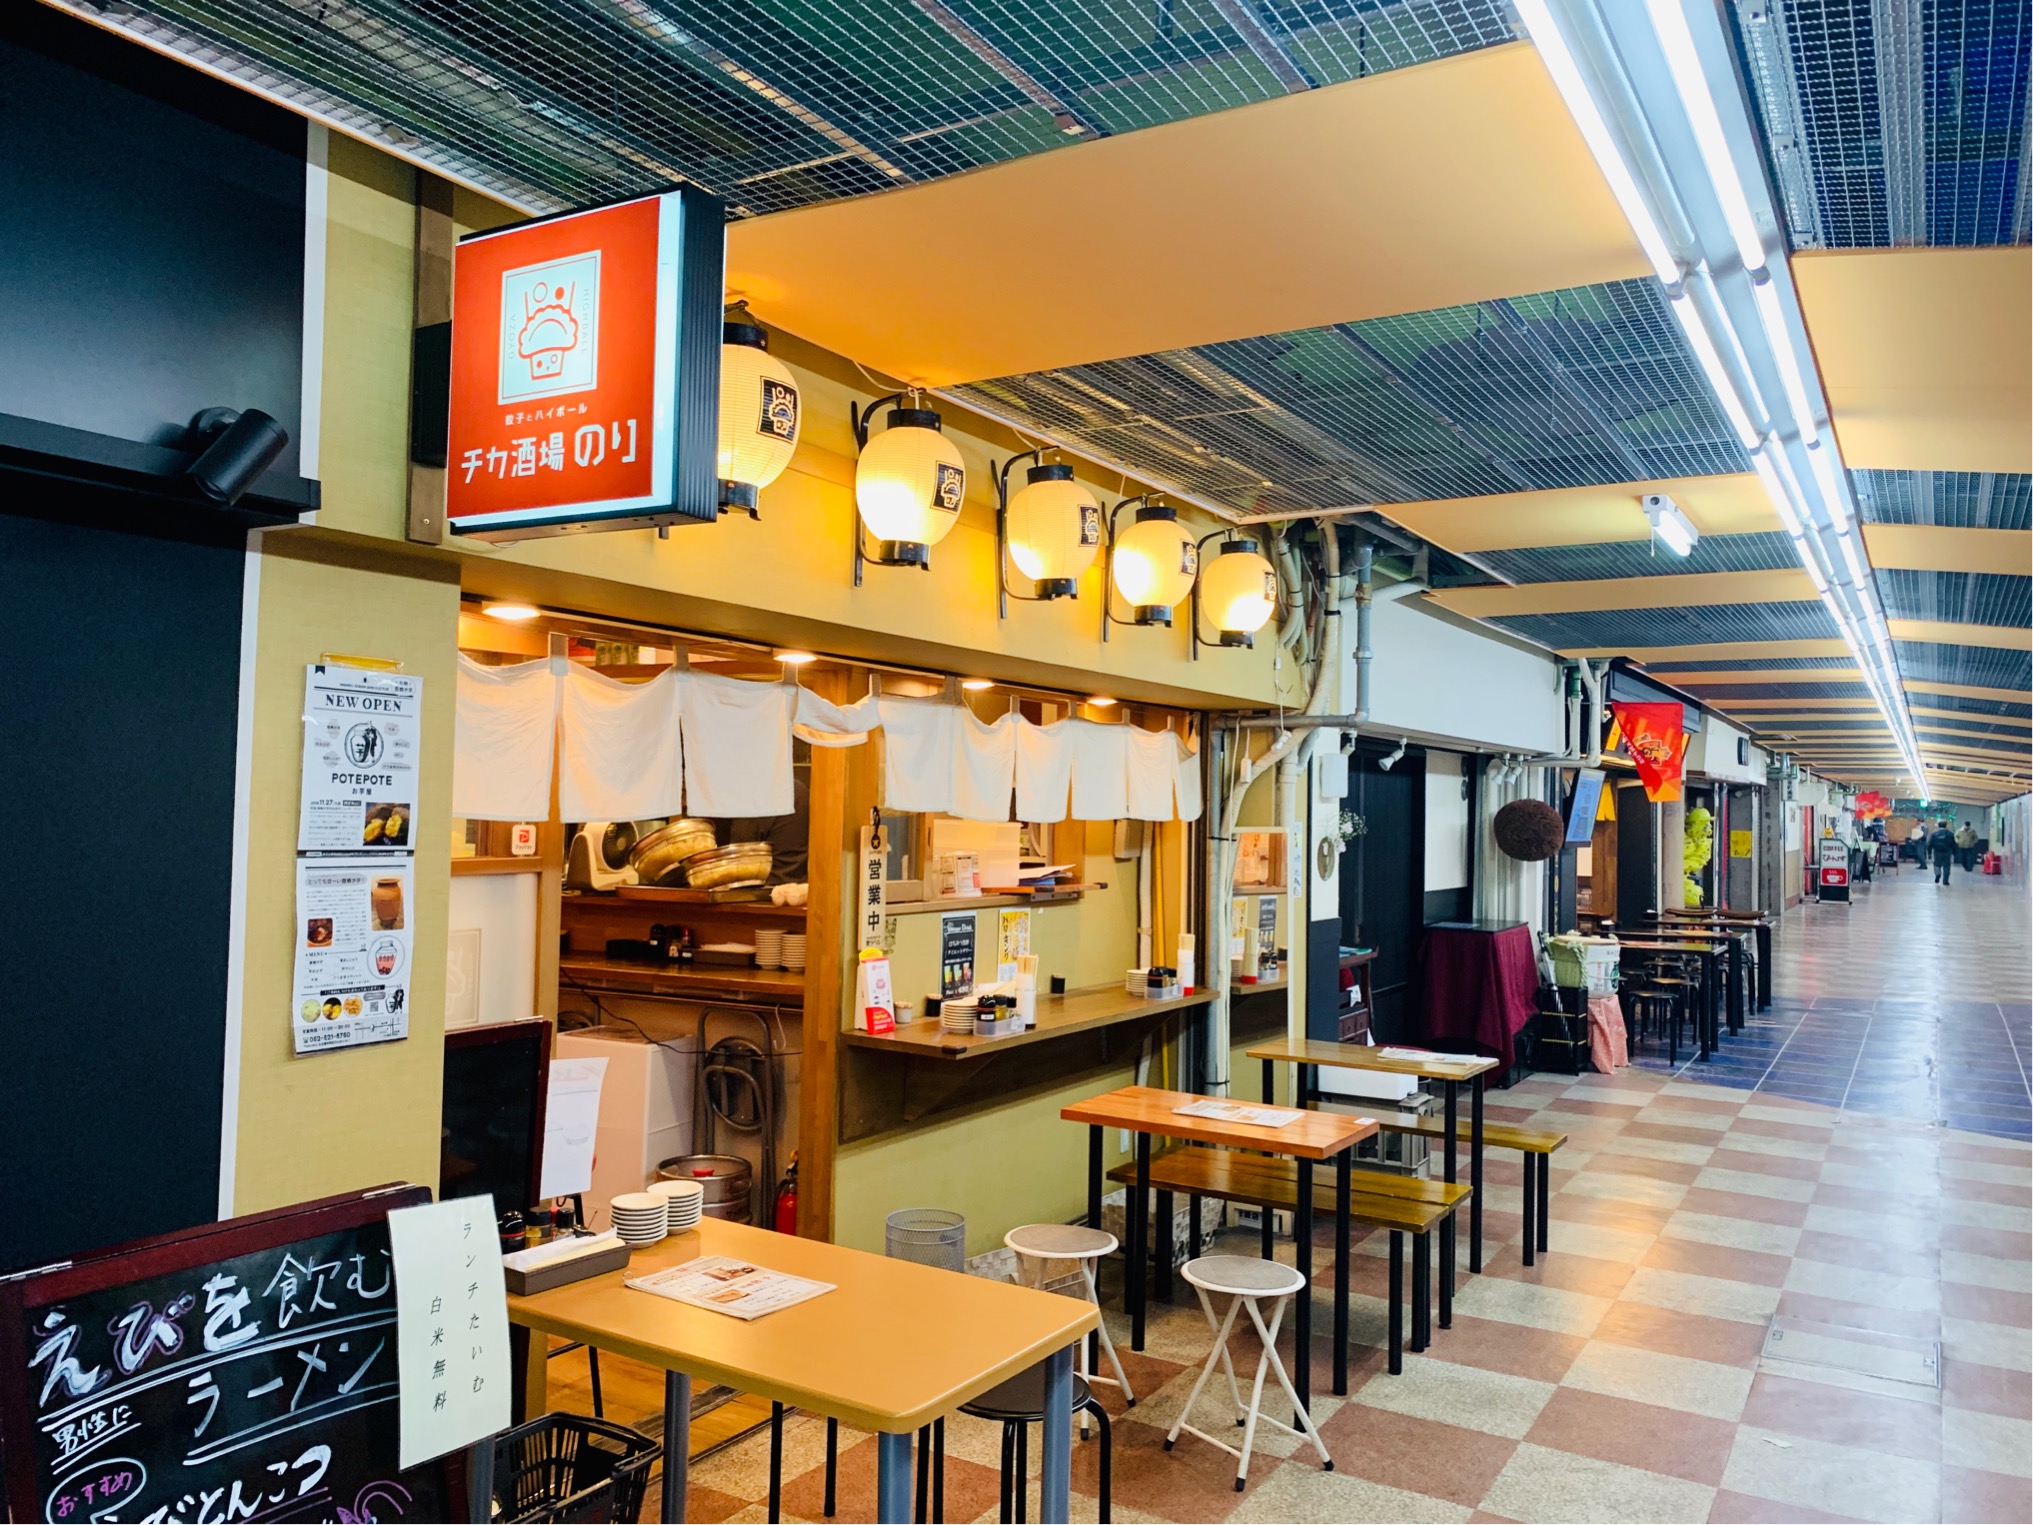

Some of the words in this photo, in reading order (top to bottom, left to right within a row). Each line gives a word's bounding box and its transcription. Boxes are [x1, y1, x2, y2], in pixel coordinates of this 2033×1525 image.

[582, 288, 591, 353] HIGHBALL
[505, 402, 588, 427] 餃子とハイボール
[460, 431, 565, 484] チカ酒場
[574, 419, 637, 468] のり
[325, 693, 359, 708] NEW
[362, 696, 402, 713] OPEN
[331, 773, 393, 786] POTEPOTE
[351, 787, 372, 796] お芋屋
[867, 858, 882, 932] 営業中
[462, 1222, 485, 1394] ランチたいむ
[429, 1295, 447, 1413] 白米無料
[187, 1336, 386, 1437] ラーメン
[52, 1405, 133, 1453] 男性に
[56, 1470, 134, 1518] おすすめ
